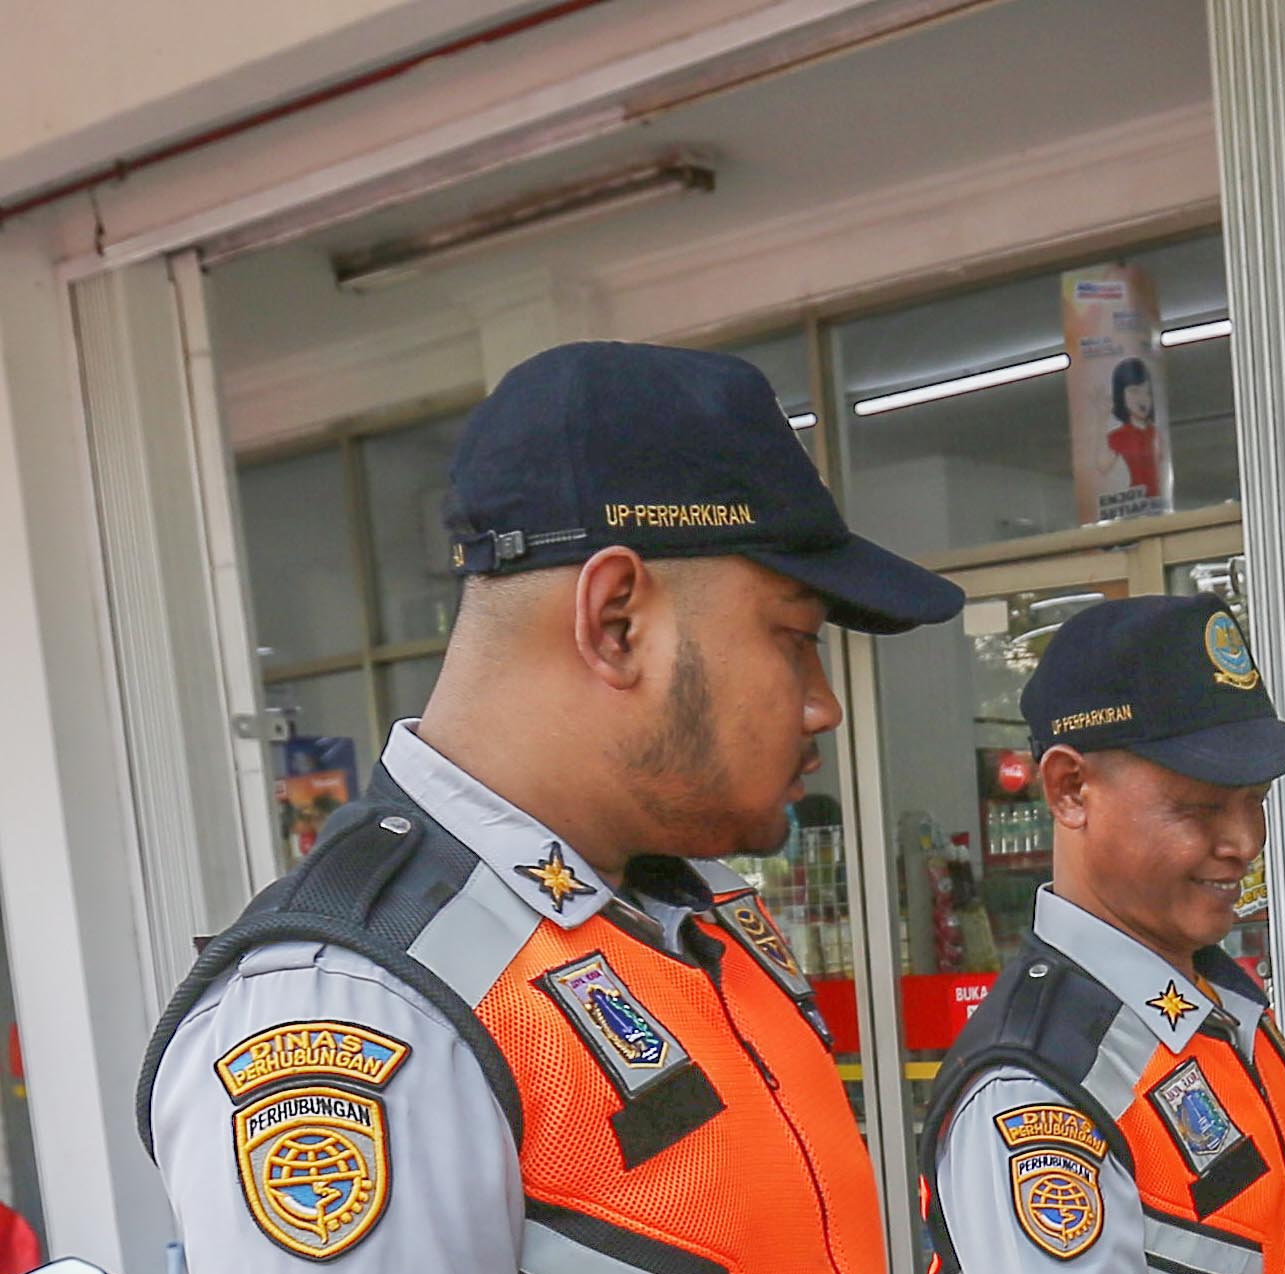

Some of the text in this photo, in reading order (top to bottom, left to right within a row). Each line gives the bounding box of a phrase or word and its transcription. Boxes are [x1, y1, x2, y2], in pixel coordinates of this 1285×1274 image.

[606, 503, 752, 526] UP PERPARKIRAN
[955, 986, 988, 1002] BUKA
[250, 1030, 363, 1061] DINAS
[233, 1048, 383, 1086] PERHUBUNGAN
[249, 1098, 371, 1138] PERHUBUNGAN
[1023, 1112, 1096, 1133] DINAS
